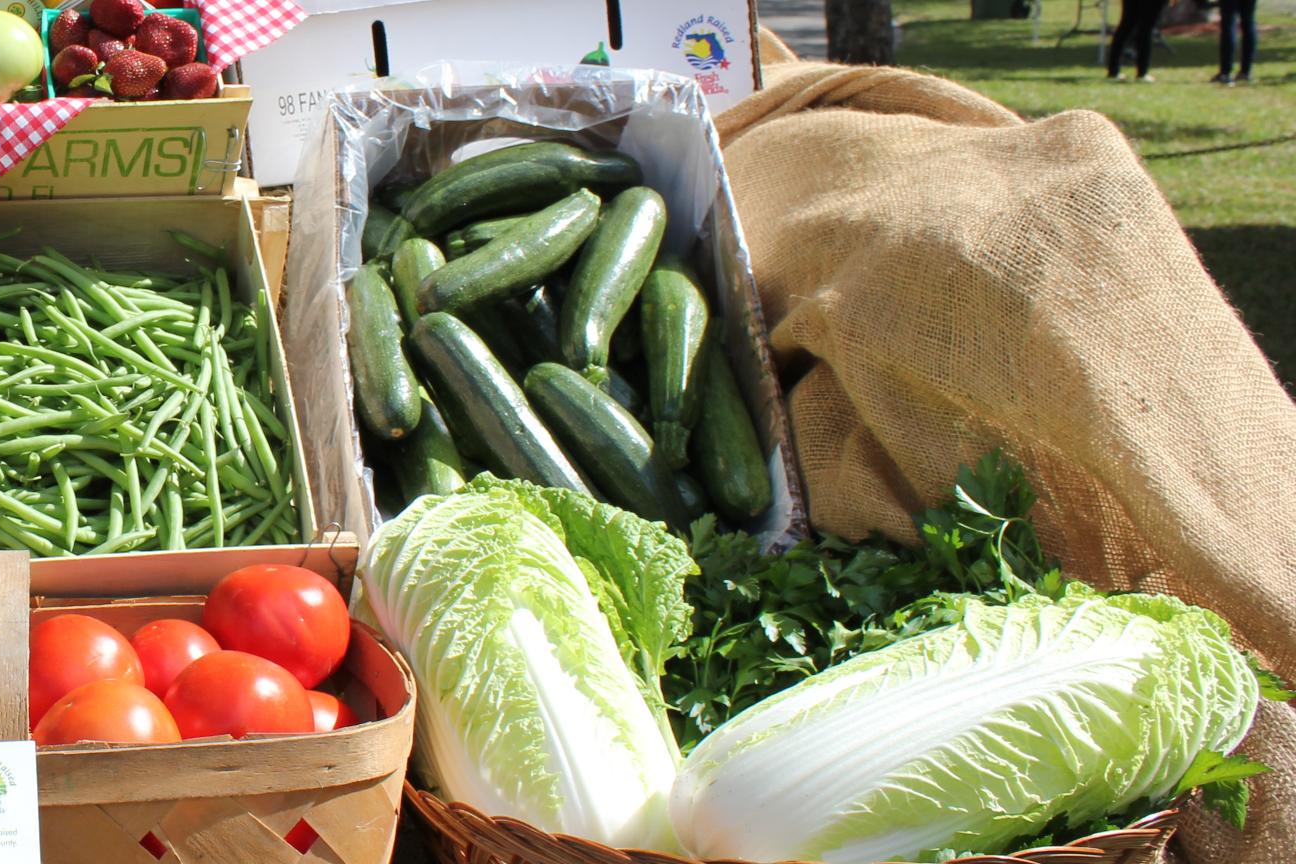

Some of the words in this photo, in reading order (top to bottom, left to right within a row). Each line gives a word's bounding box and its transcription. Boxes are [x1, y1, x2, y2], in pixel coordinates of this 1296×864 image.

[672, 14, 704, 49] Redland
[706, 16, 735, 43] Raised
[278, 95, 295, 116] 98
[22, 136, 191, 178] ARMS
